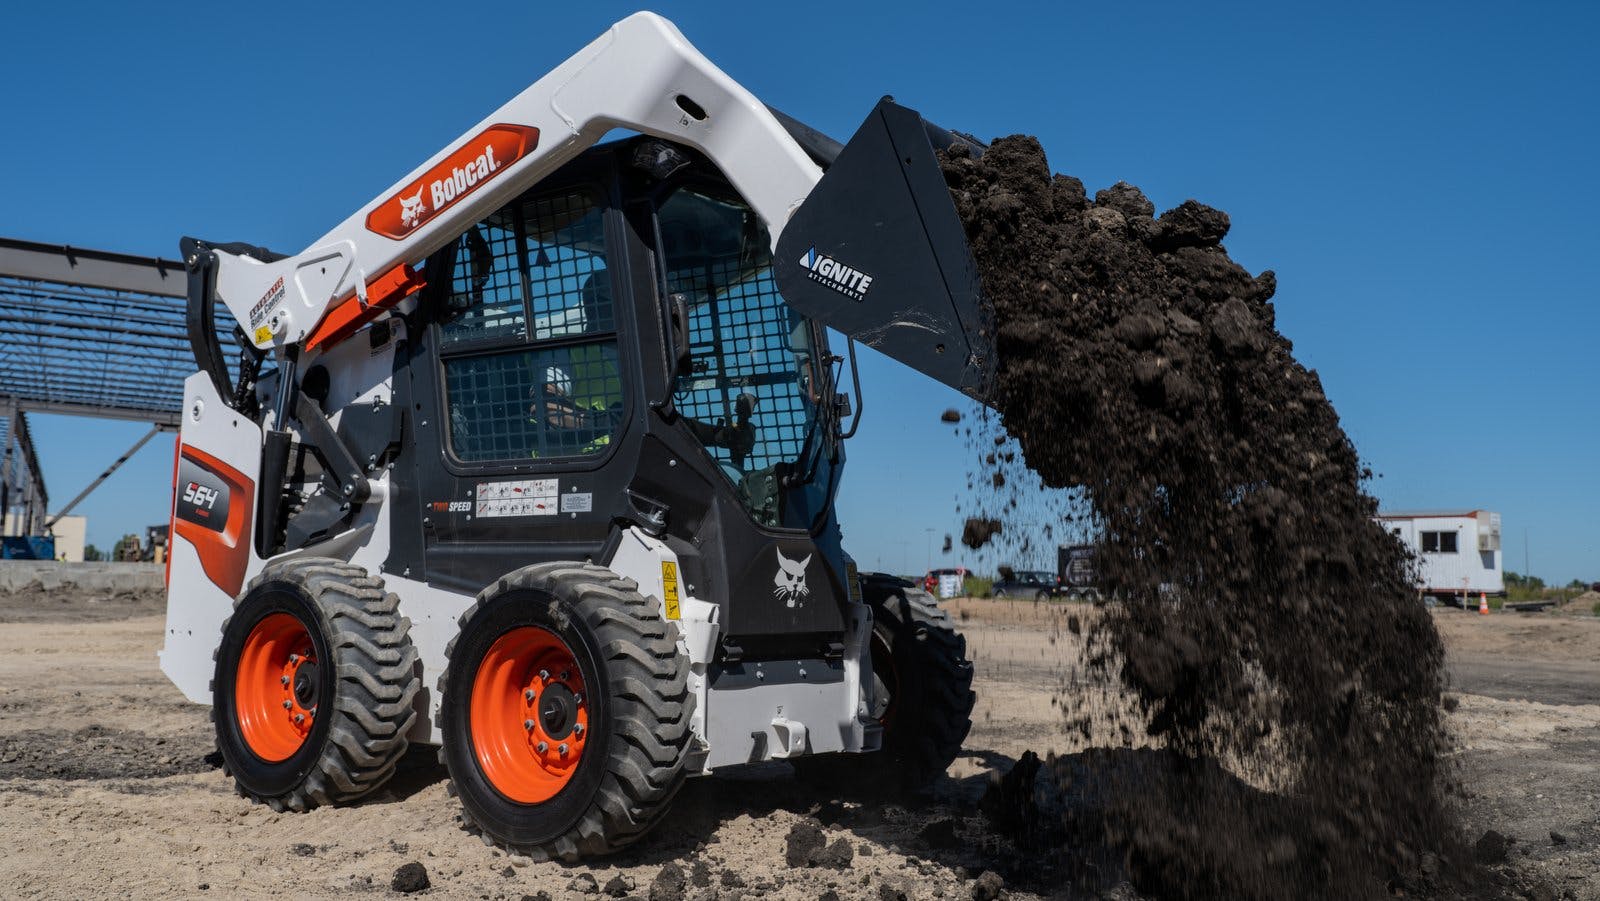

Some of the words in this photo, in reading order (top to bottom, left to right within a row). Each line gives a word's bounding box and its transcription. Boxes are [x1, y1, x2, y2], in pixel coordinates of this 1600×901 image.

[430, 144, 498, 211] Bobcat
[808, 272, 864, 301] ATTACHMENTS
[811, 254, 873, 294] IGNITE
[182, 482, 219, 510] S64
[448, 501, 472, 512] SPEED
